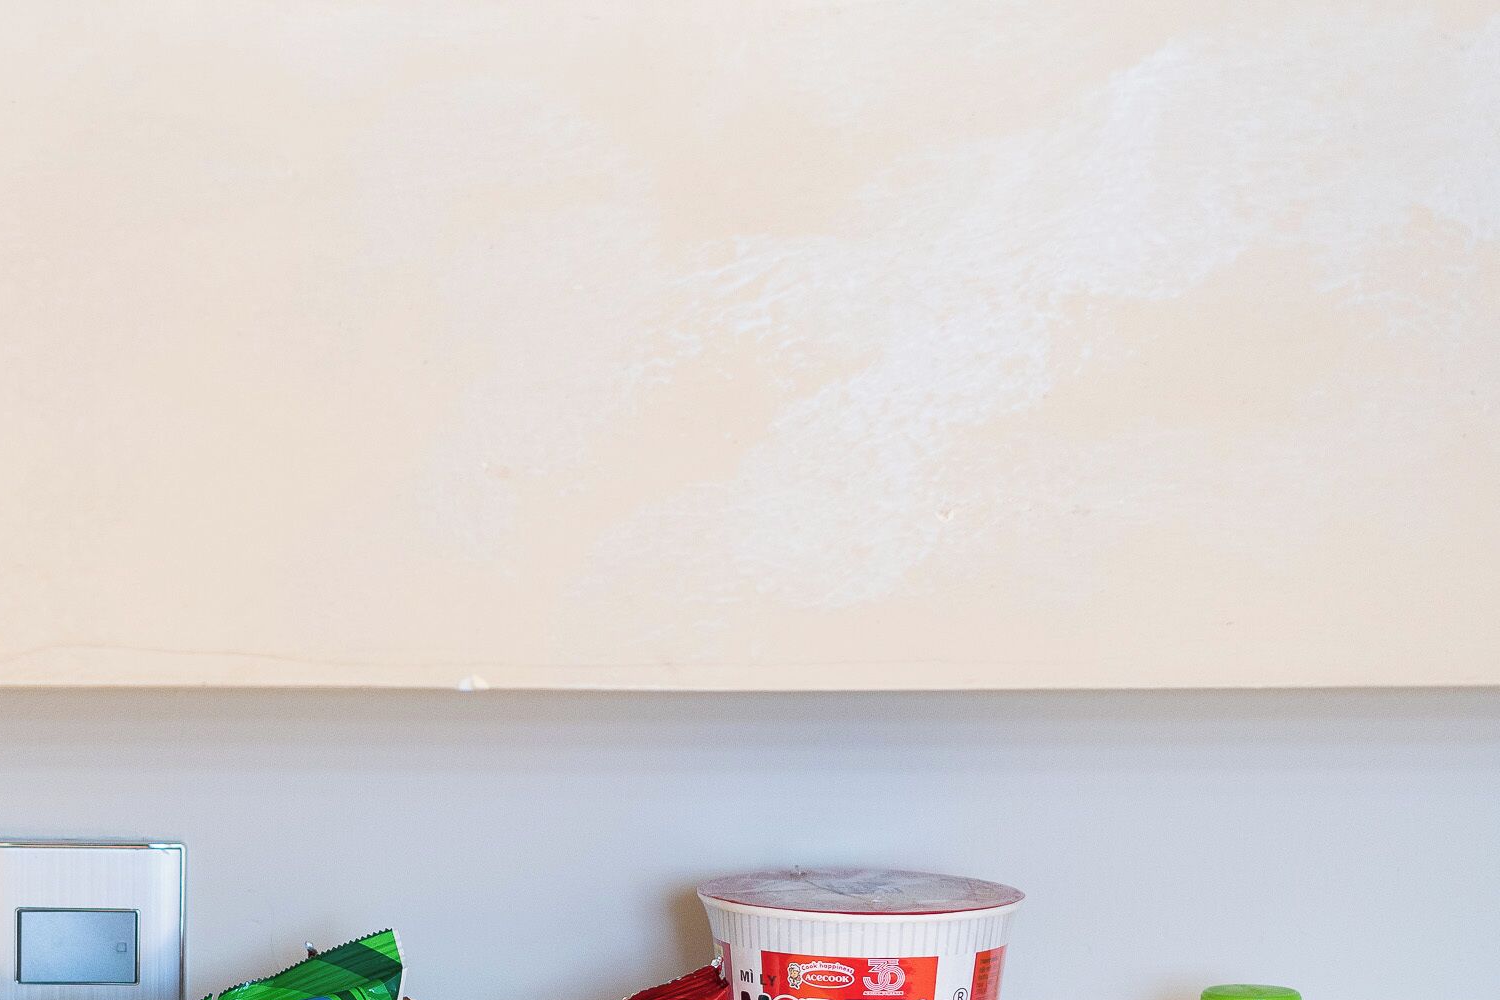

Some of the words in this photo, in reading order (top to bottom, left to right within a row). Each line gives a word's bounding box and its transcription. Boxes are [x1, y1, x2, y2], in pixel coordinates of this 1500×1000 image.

[819, 961, 854, 974] happiness
[740, 969, 754, 983] MÌ
[760, 974, 777, 986] LY
